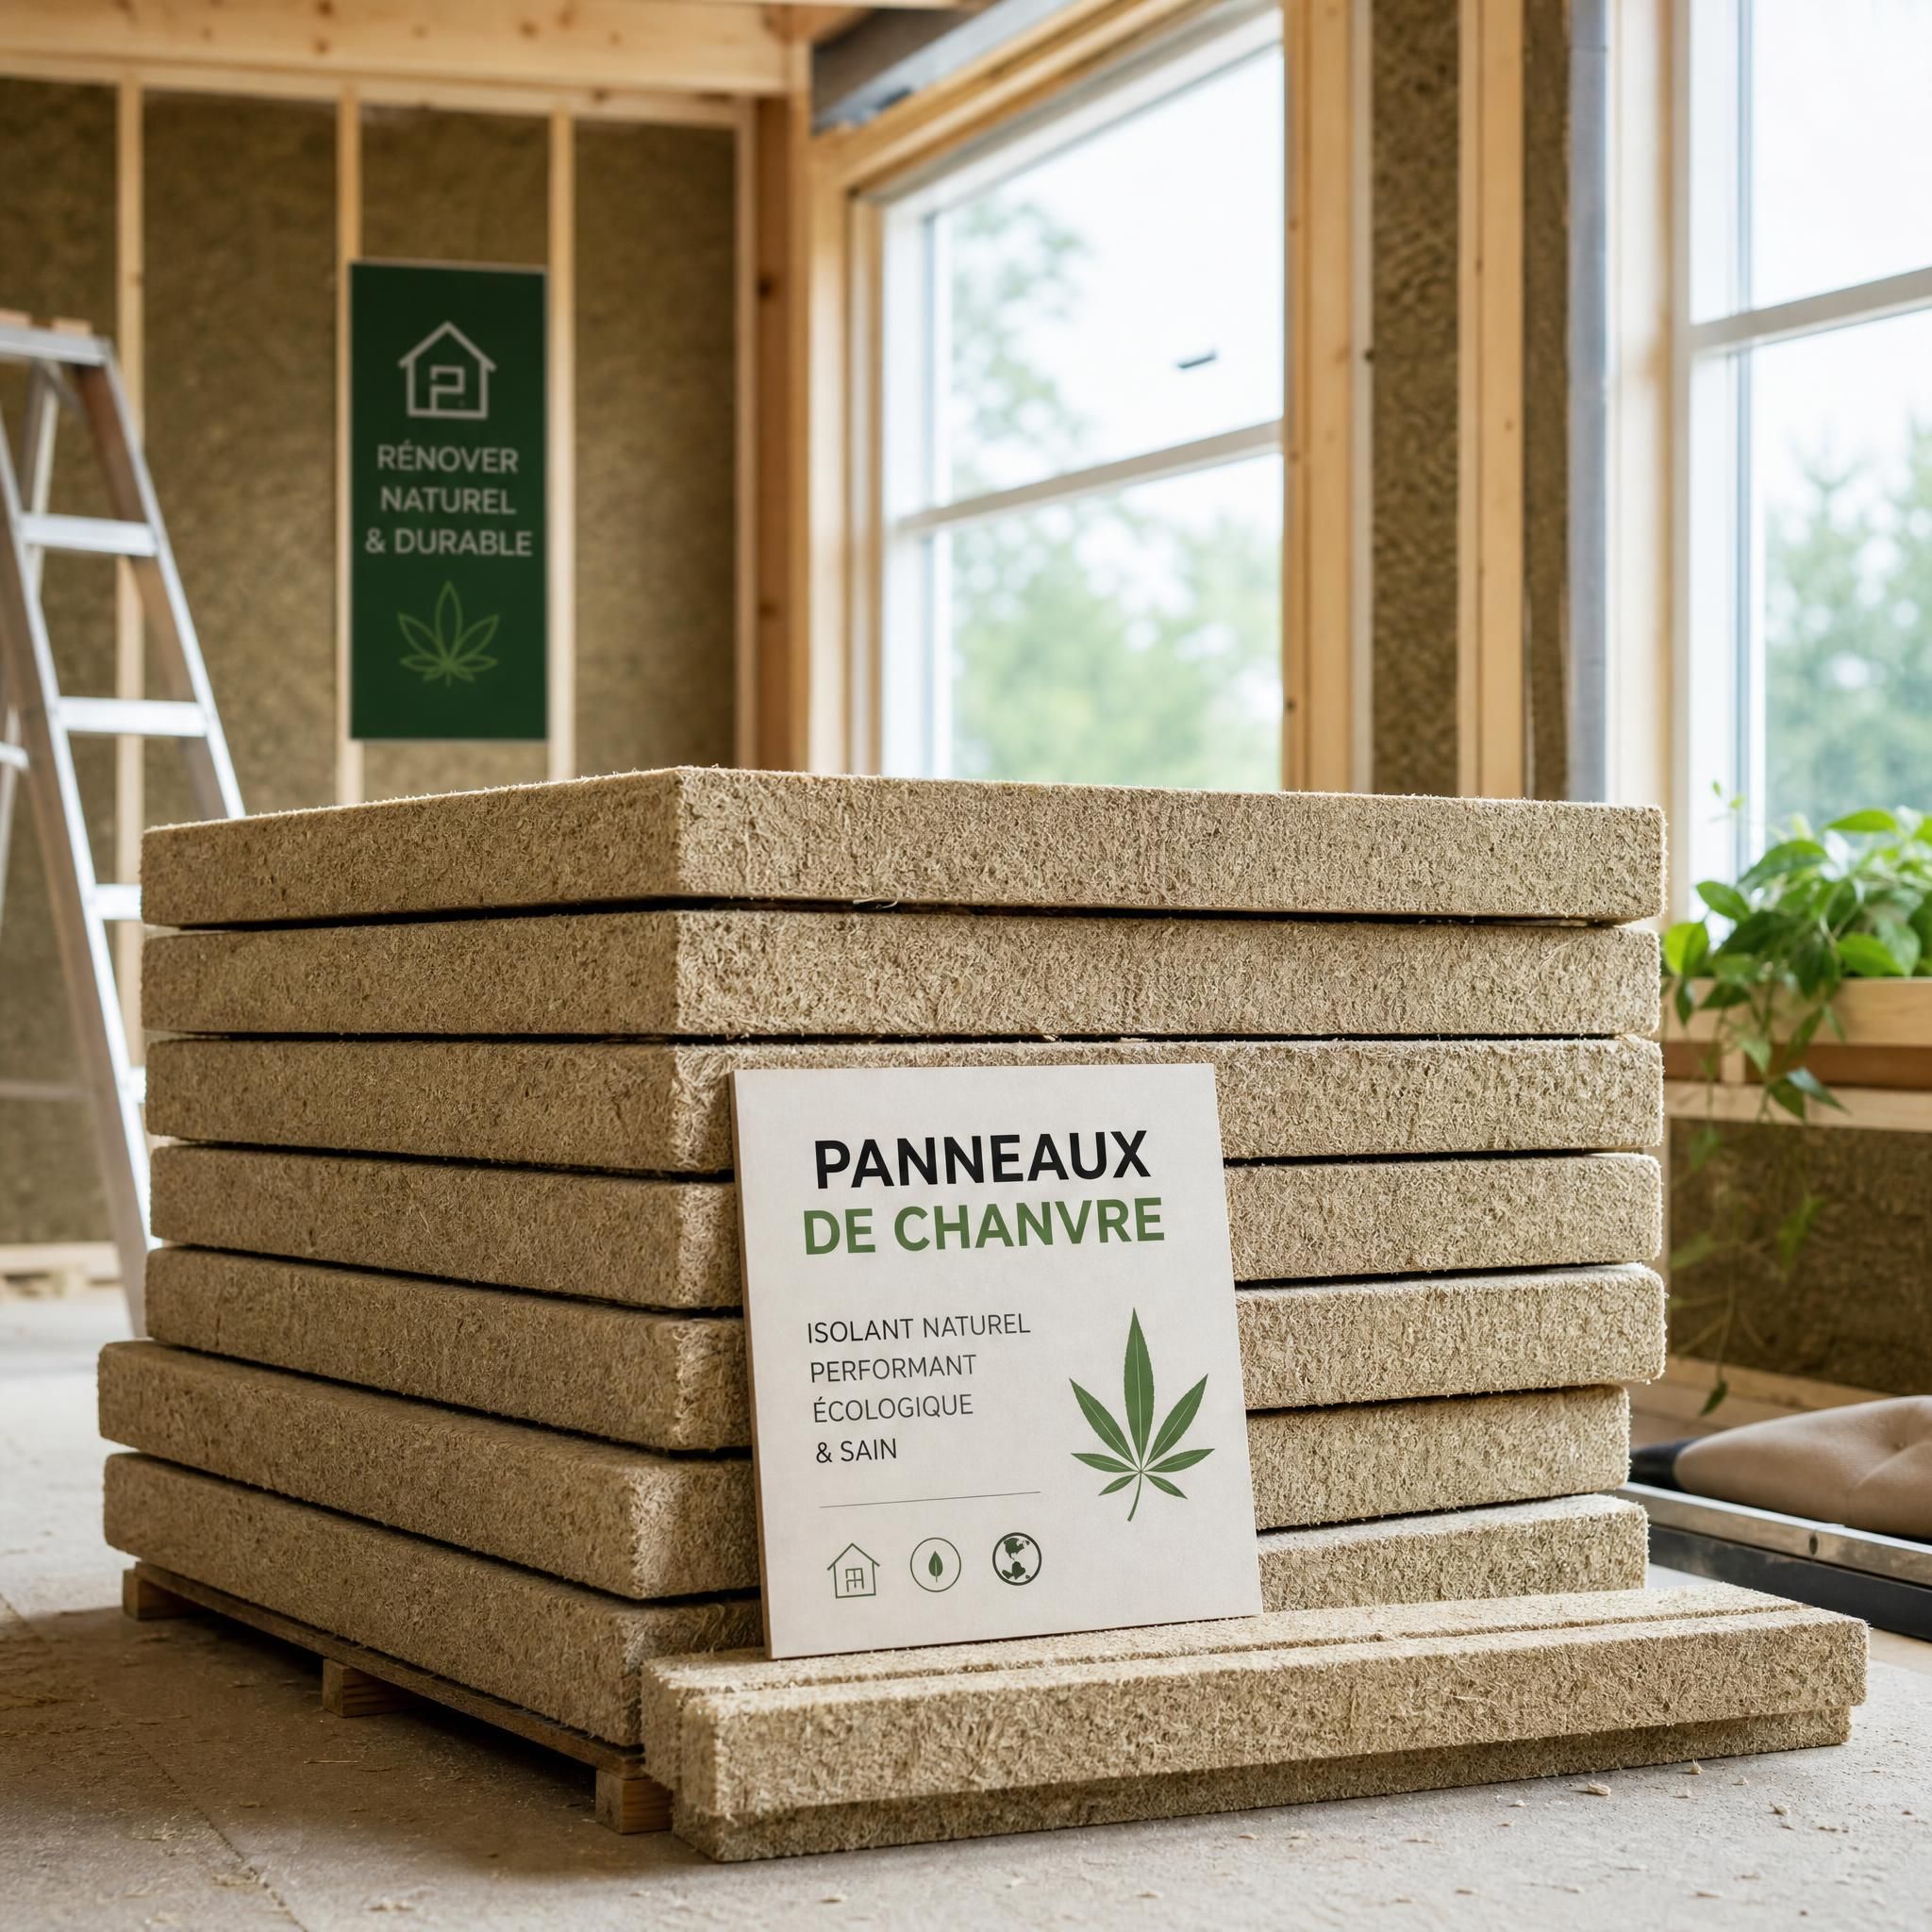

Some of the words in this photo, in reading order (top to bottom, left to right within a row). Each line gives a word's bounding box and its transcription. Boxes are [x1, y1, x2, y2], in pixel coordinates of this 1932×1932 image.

[377, 439, 520, 474] RÉNOVER
[380, 487, 517, 515] NATUREL
[364, 527, 386, 554] &
[394, 528, 533, 557] DURABLE
[814, 1129, 1152, 1191] PANNEAUX
[803, 1208, 876, 1256] DE
[893, 1196, 1166, 1253] CHANVRE
[807, 1318, 914, 1344] ISOLANT
[923, 1312, 1032, 1339] NATUREL
[809, 1354, 978, 1384] PERFORMANT
[812, 1393, 974, 1424] ÉCOLOGIQUE
[815, 1441, 833, 1464] &
[840, 1437, 898, 1463] SAIN
